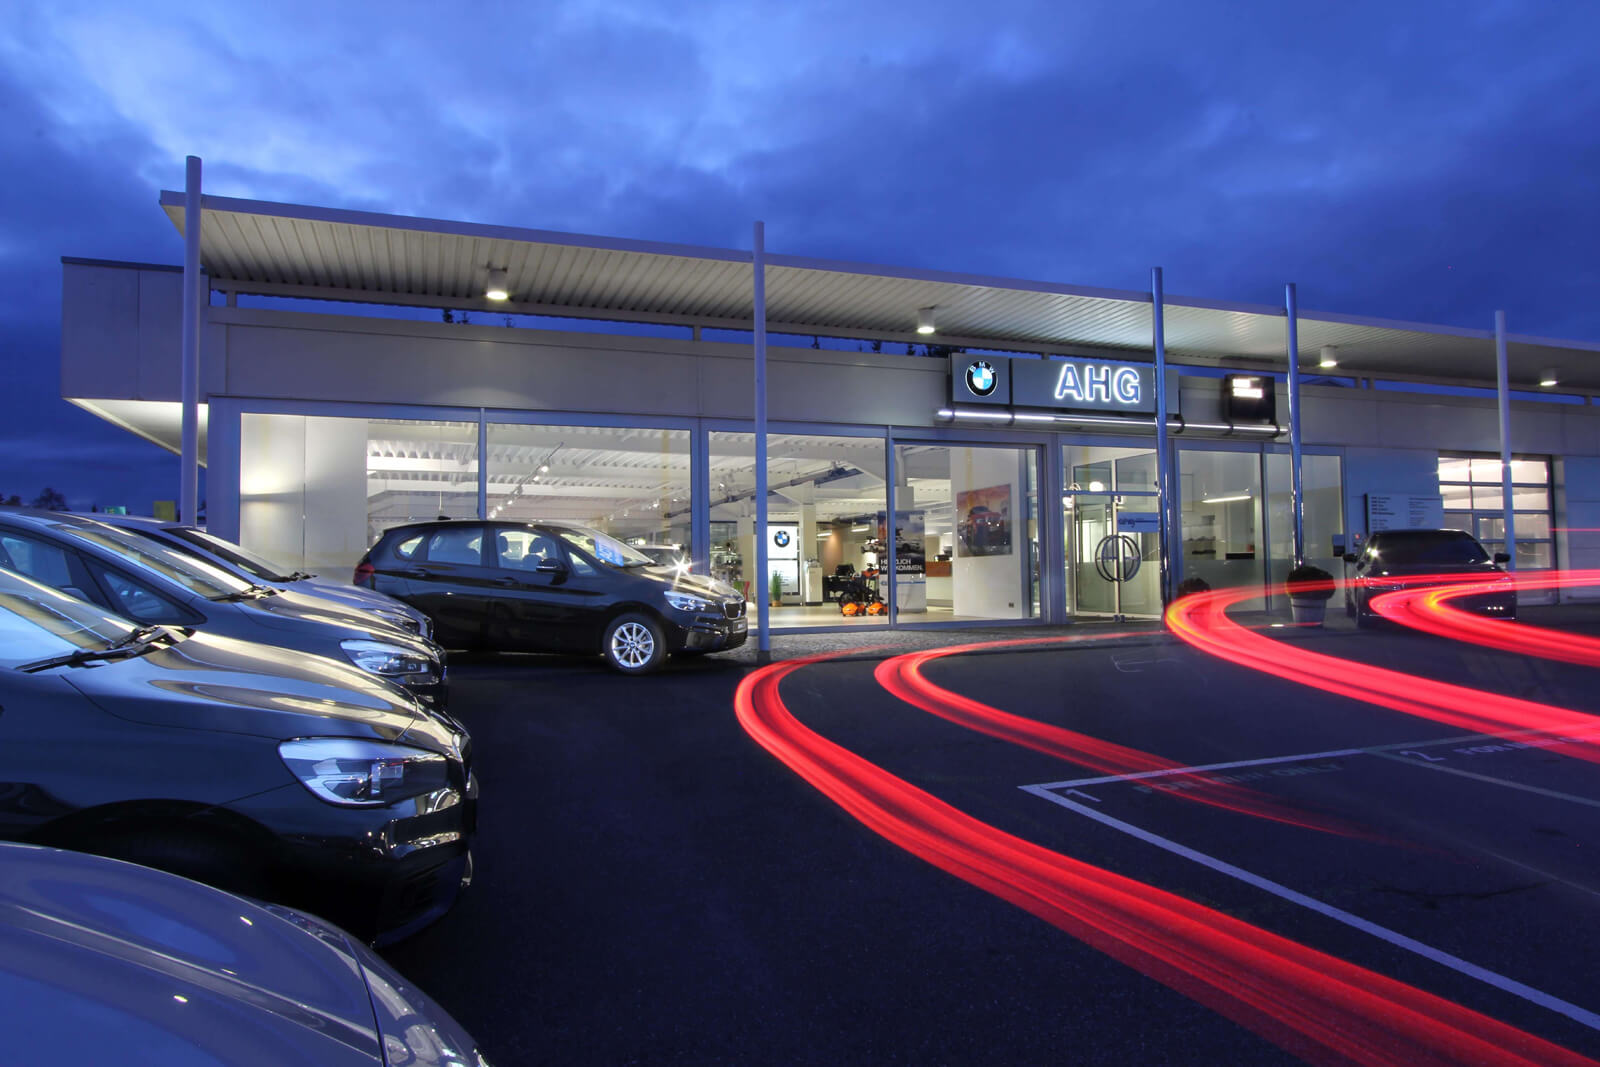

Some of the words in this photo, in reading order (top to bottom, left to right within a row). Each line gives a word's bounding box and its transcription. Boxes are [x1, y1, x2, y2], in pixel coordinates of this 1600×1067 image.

[1054, 363, 1141, 404] AHG
[1399, 749, 1446, 762] 2
[1065, 788, 1102, 802] 1
